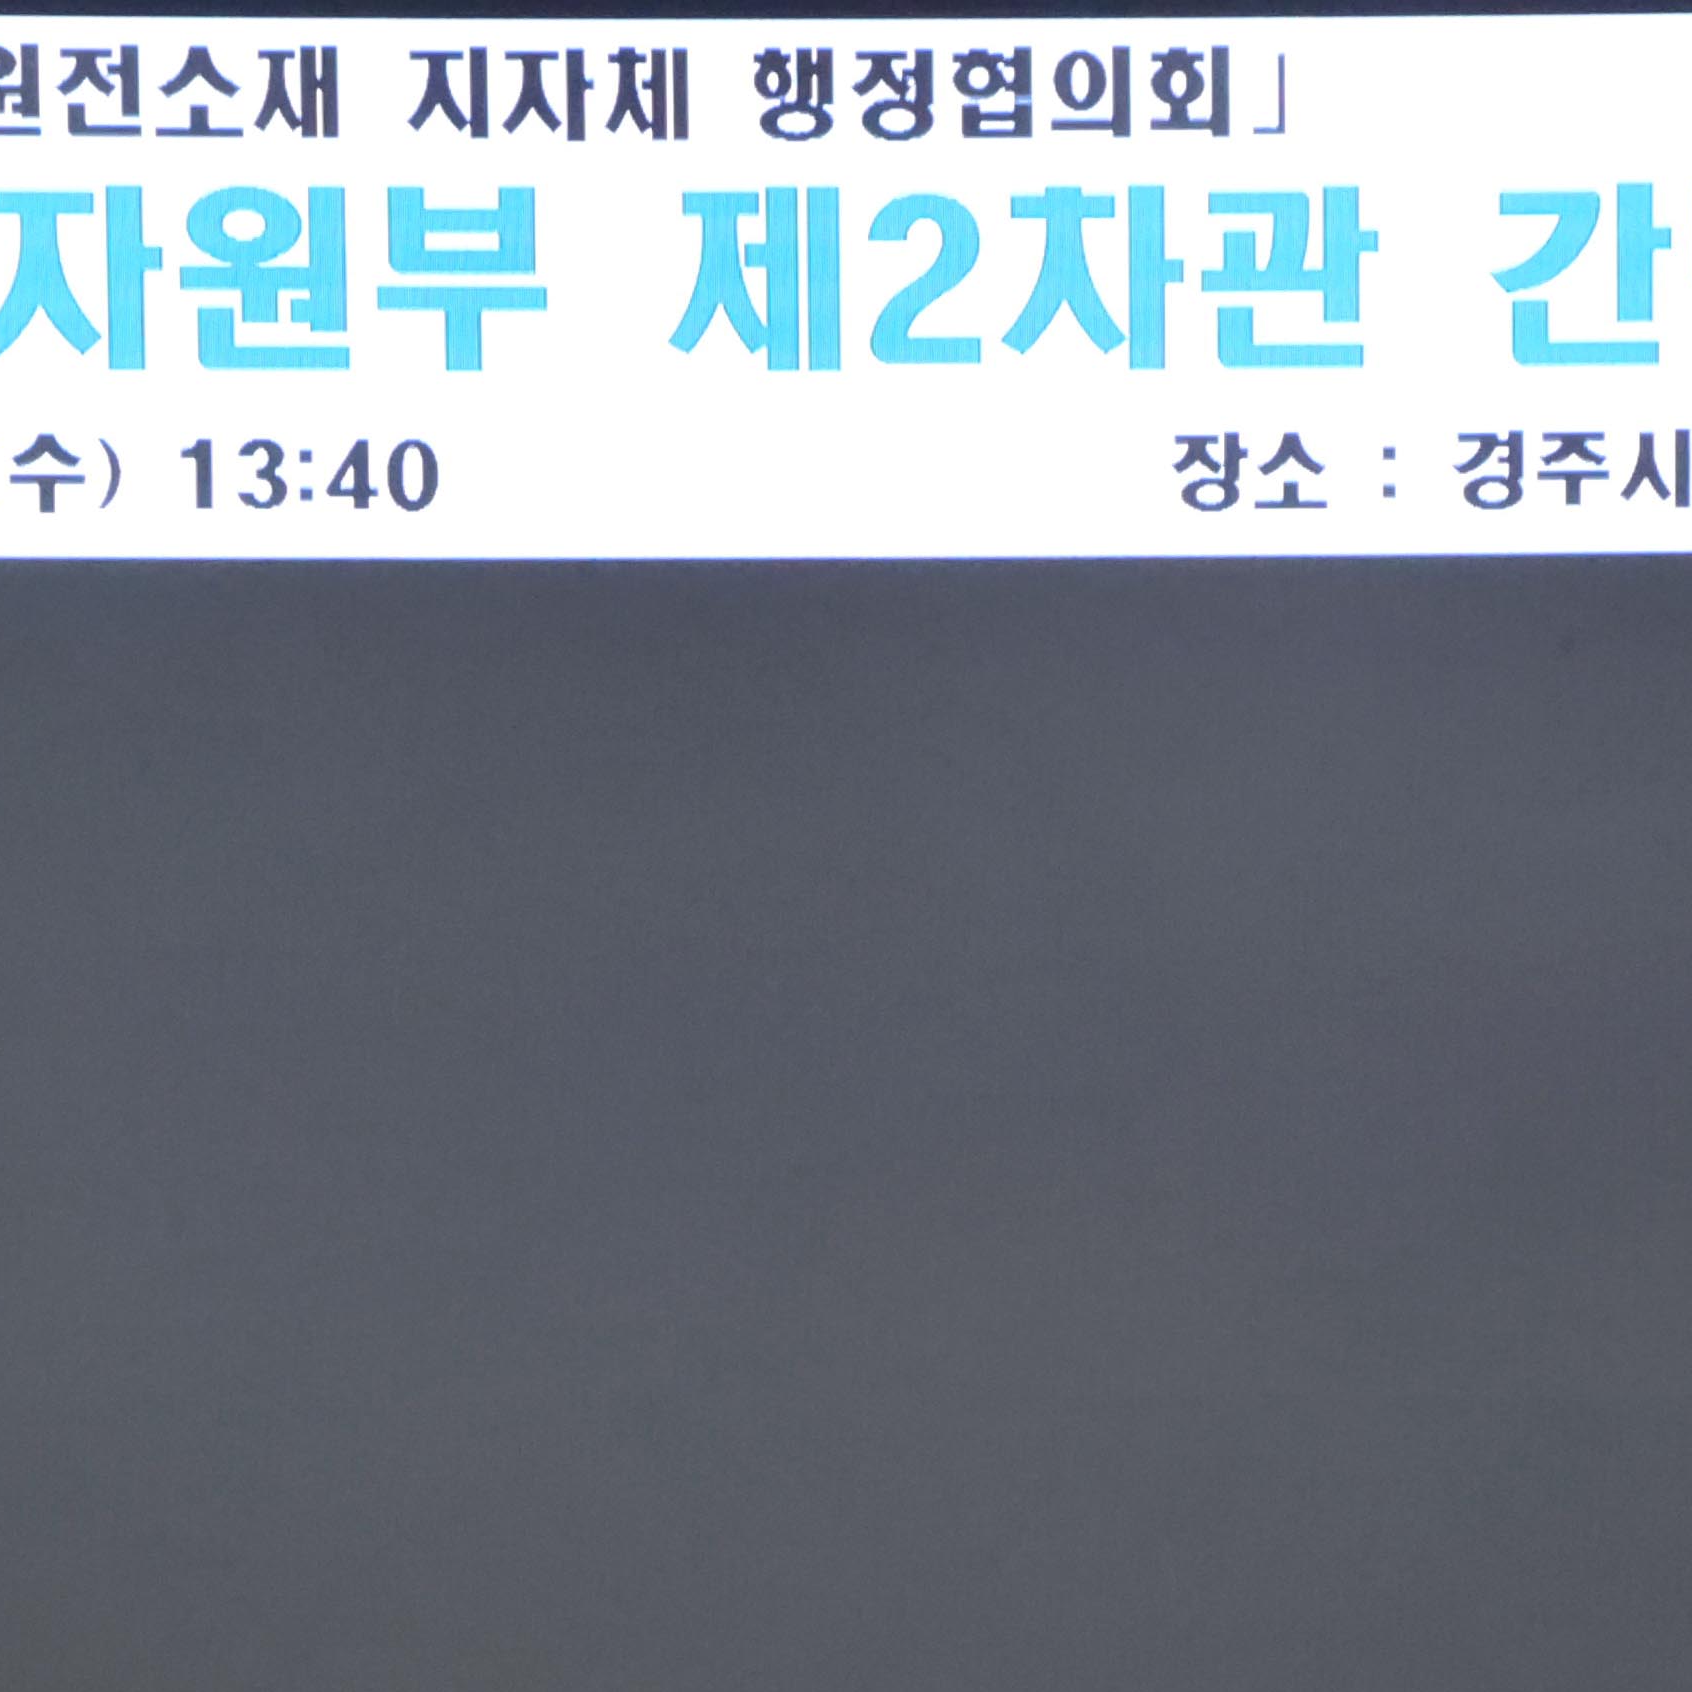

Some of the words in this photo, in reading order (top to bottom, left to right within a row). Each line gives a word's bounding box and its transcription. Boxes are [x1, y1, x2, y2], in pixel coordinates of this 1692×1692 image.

[408, 46, 689, 142] 지자체
[754, 44, 1286, 142] 행정협의회」
[668, 184, 1379, 373] 제2차관
[180, 438, 439, 512] 13:40
[1173, 431, 1328, 512] 장소
